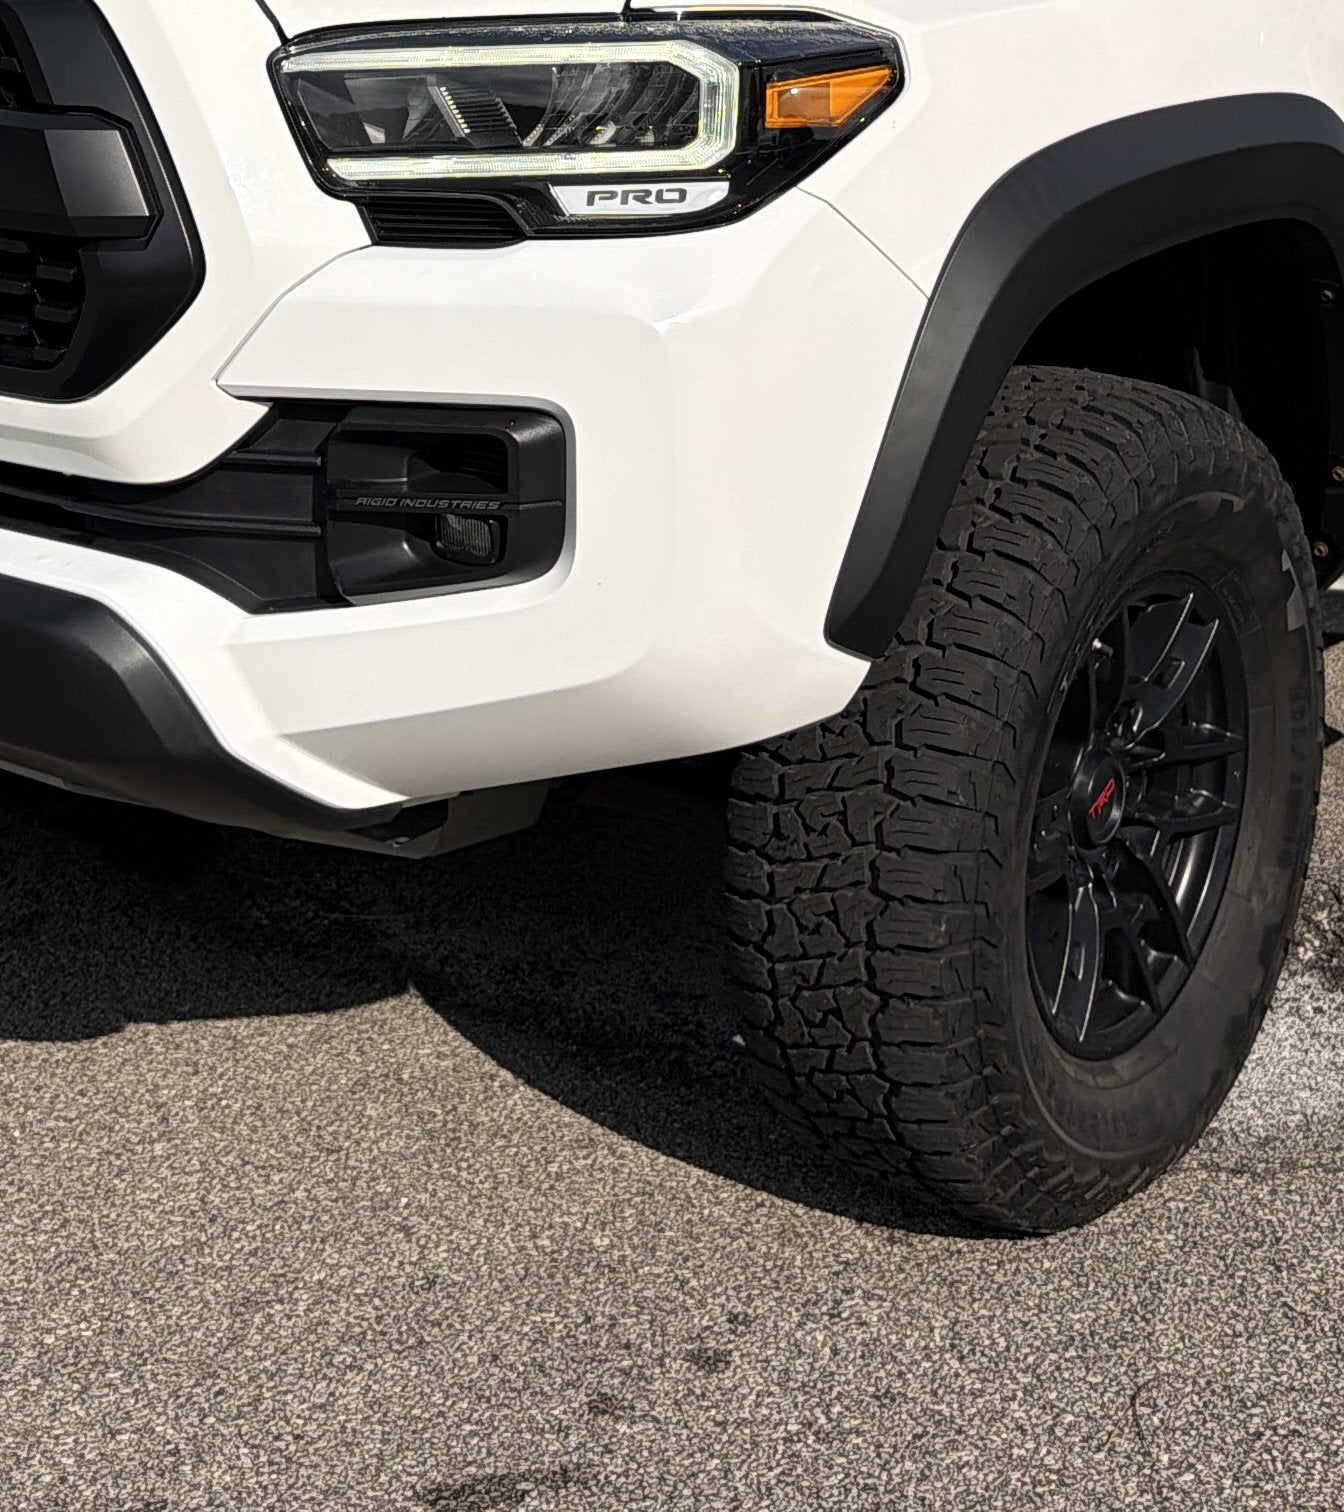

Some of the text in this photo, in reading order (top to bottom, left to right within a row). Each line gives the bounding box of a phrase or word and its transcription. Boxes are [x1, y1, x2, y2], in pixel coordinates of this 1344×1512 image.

[586, 188, 688, 206] PRO
[356, 497, 501, 510] RIGID INDUSTRIES
